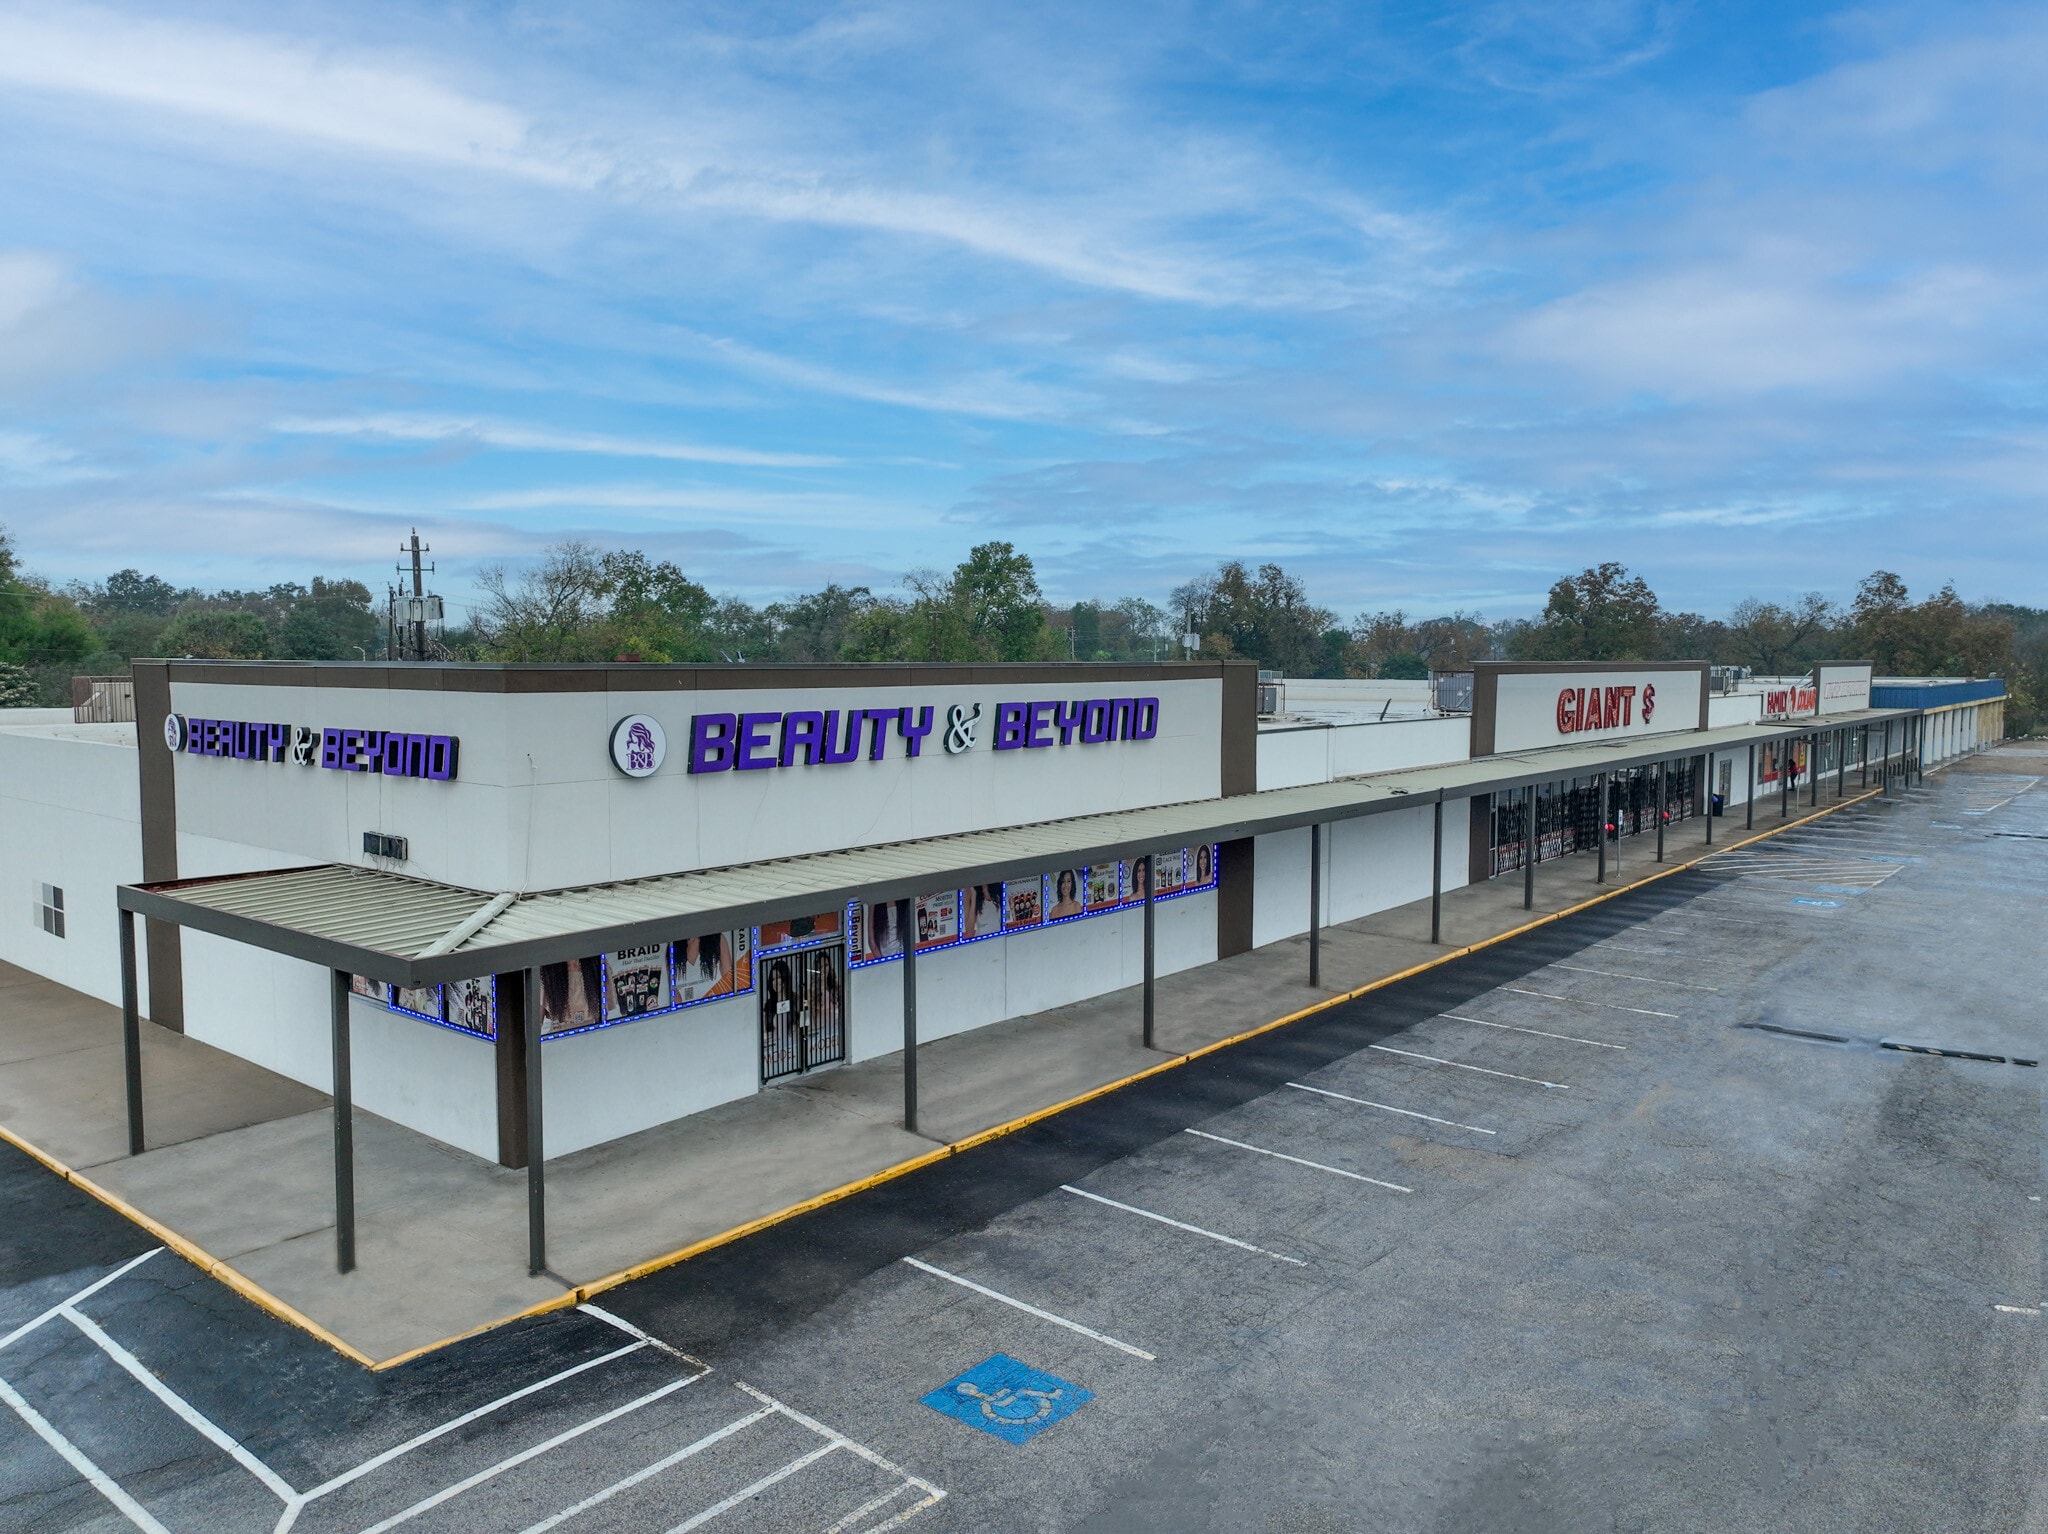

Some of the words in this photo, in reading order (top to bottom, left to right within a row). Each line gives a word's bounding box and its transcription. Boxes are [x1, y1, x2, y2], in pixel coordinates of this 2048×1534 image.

[1557, 686, 1636, 733] GIANT
[1642, 684, 1655, 724] $
[188, 718, 287, 762] BEAUTY
[292, 727, 315, 766] &
[322, 728, 453, 780] BEYOND
[688, 706, 934, 774] BEAUTY
[944, 703, 982, 754] &
[993, 697, 1160, 750] BEYOND
[626, 751, 656, 770] B&B
[617, 943, 661, 961] BRAID
